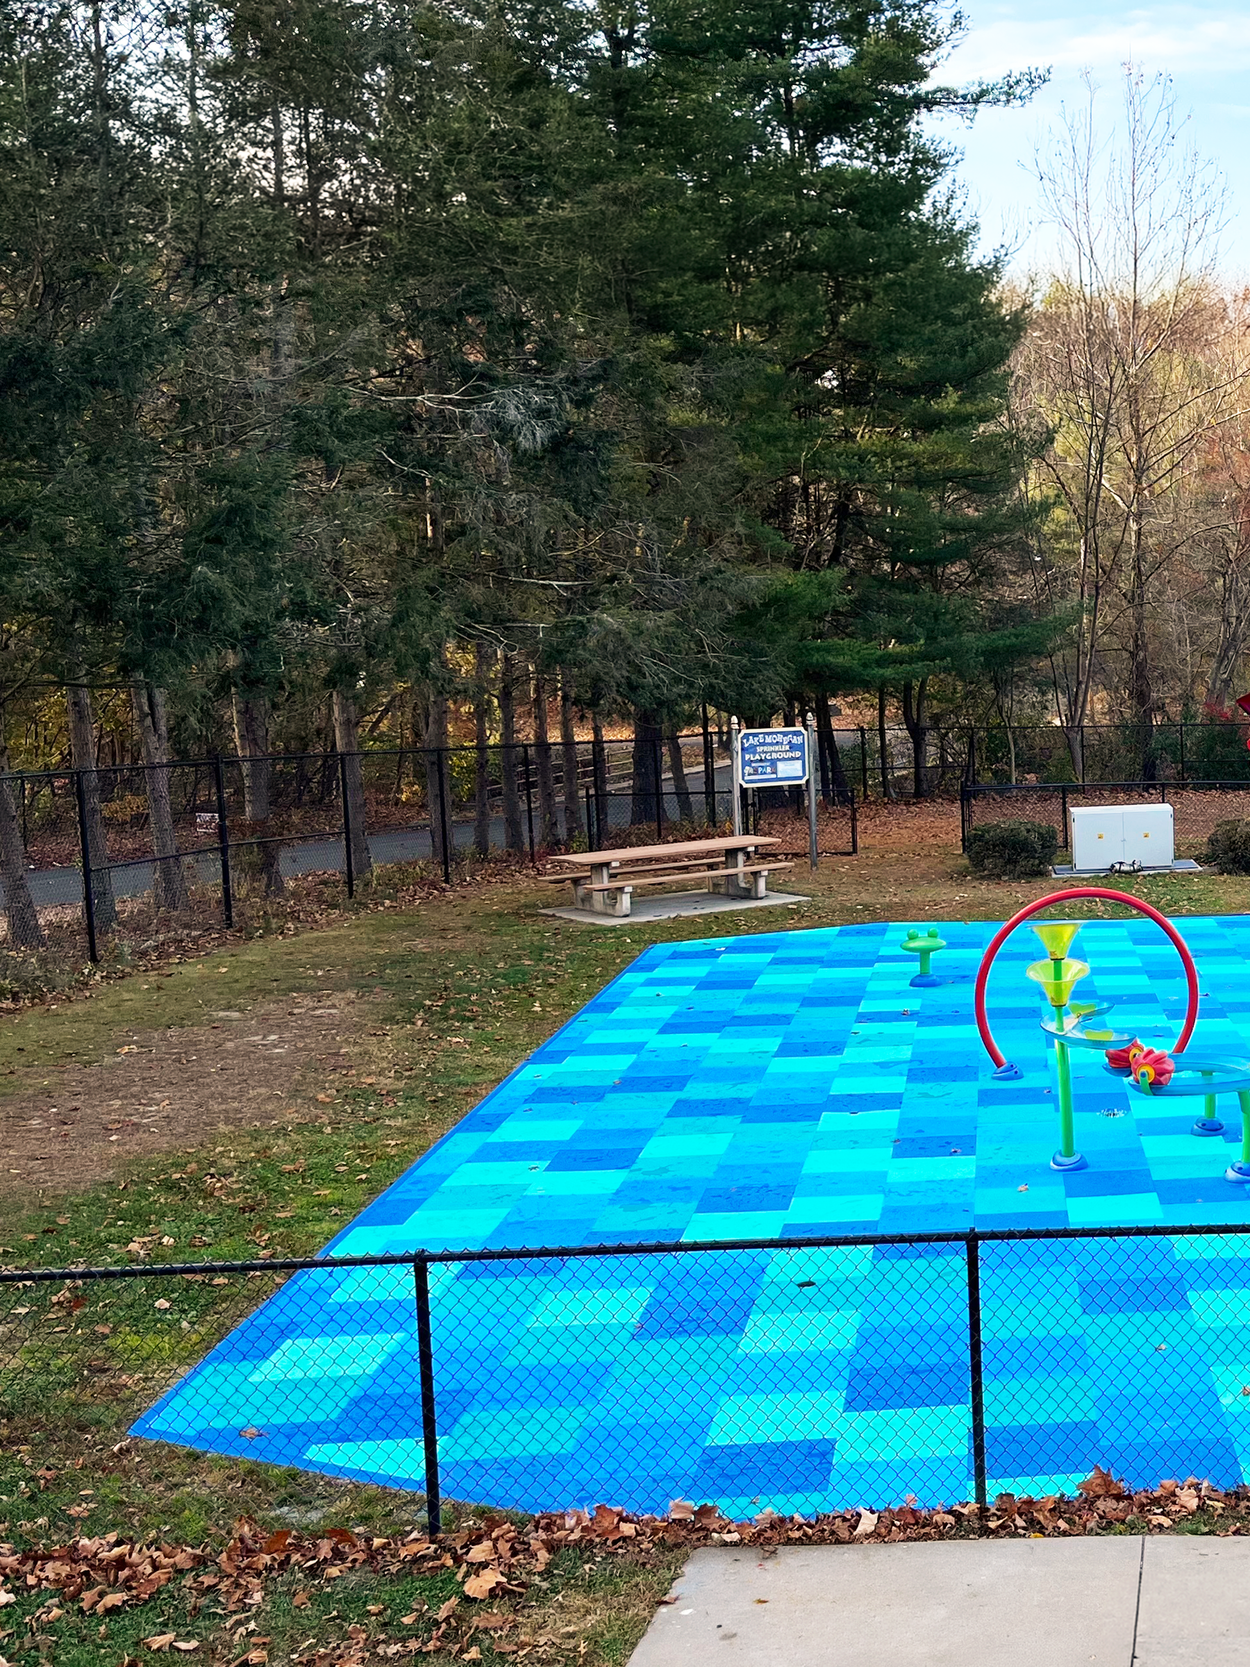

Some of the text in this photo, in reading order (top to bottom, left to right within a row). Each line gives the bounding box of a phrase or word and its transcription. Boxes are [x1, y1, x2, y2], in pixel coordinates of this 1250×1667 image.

[743, 733, 803, 747] LAKE MOHEGAN
[745, 751, 801, 760] PLAYGROUND
